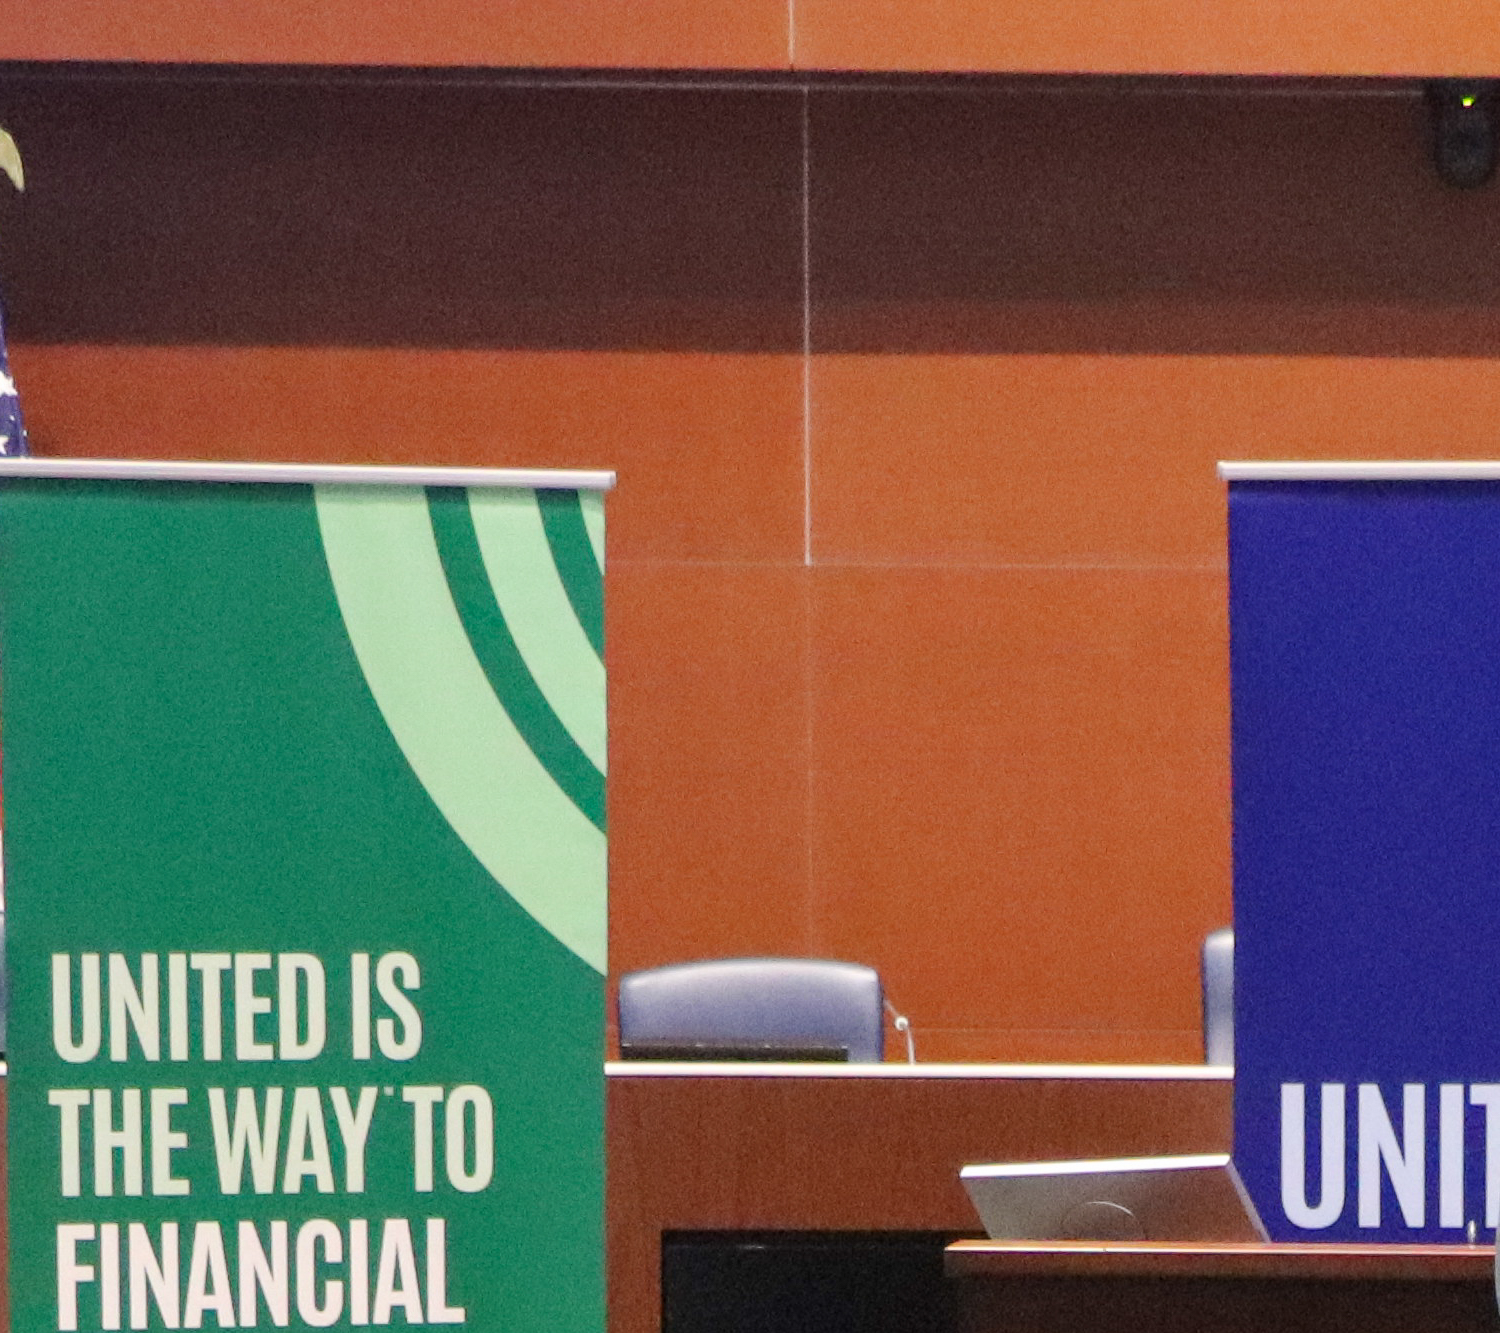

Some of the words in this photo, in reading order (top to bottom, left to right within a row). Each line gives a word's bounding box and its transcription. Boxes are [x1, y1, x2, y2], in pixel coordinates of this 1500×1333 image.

[52, 953, 326, 1062] UNITED
[351, 951, 422, 1060] IS
[48, 1088, 190, 1196] THE
[402, 1085, 493, 1192] TO
[57, 1218, 465, 1331] FINANCIAL
